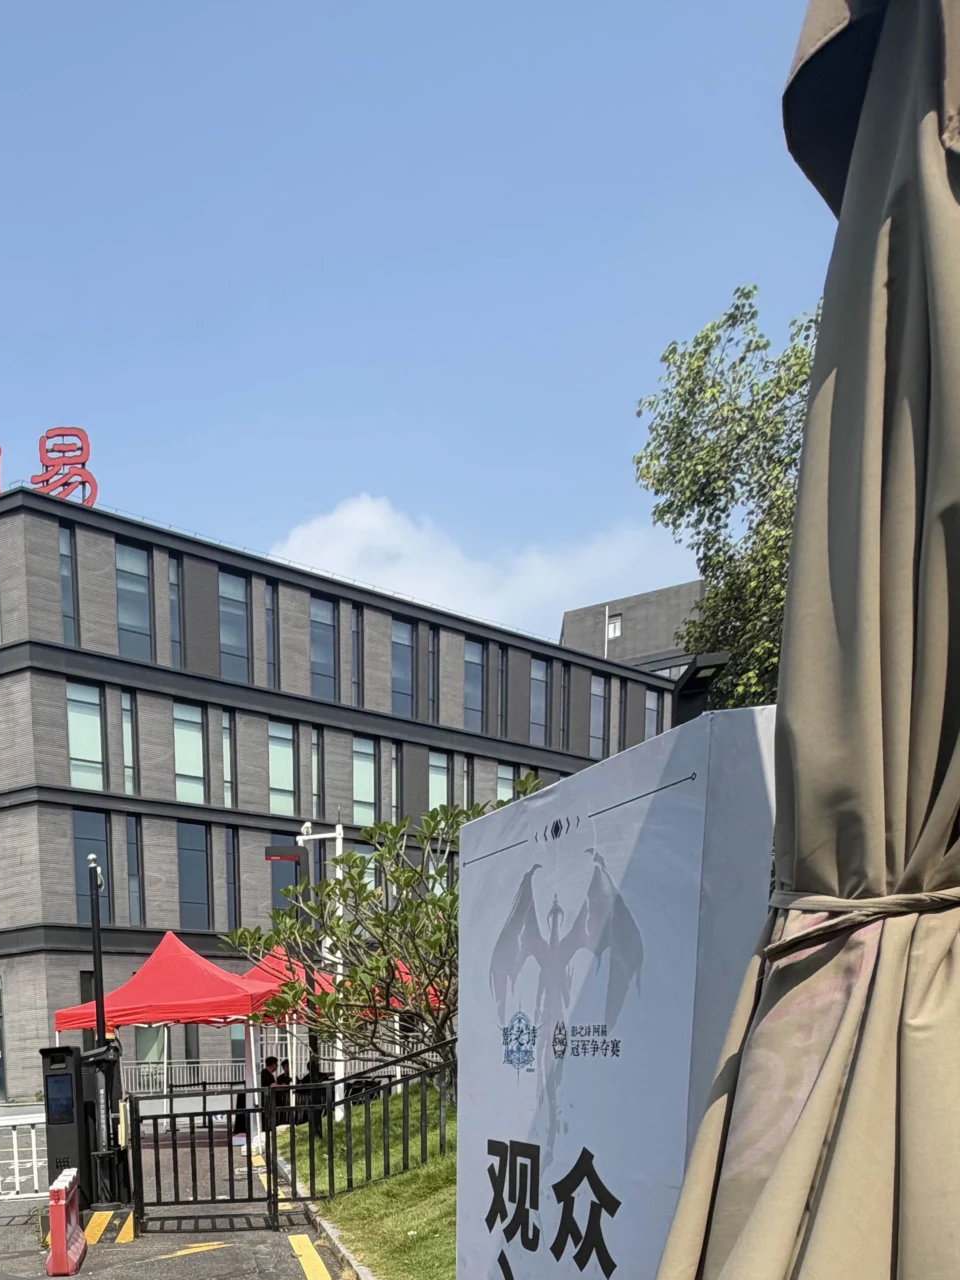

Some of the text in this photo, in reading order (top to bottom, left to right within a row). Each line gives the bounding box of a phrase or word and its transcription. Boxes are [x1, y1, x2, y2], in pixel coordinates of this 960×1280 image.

[502, 1026, 538, 1046] 影之诗
[570, 1038, 621, 1057] 冠军争夺赛
[485, 1139, 622, 1280] 观众
